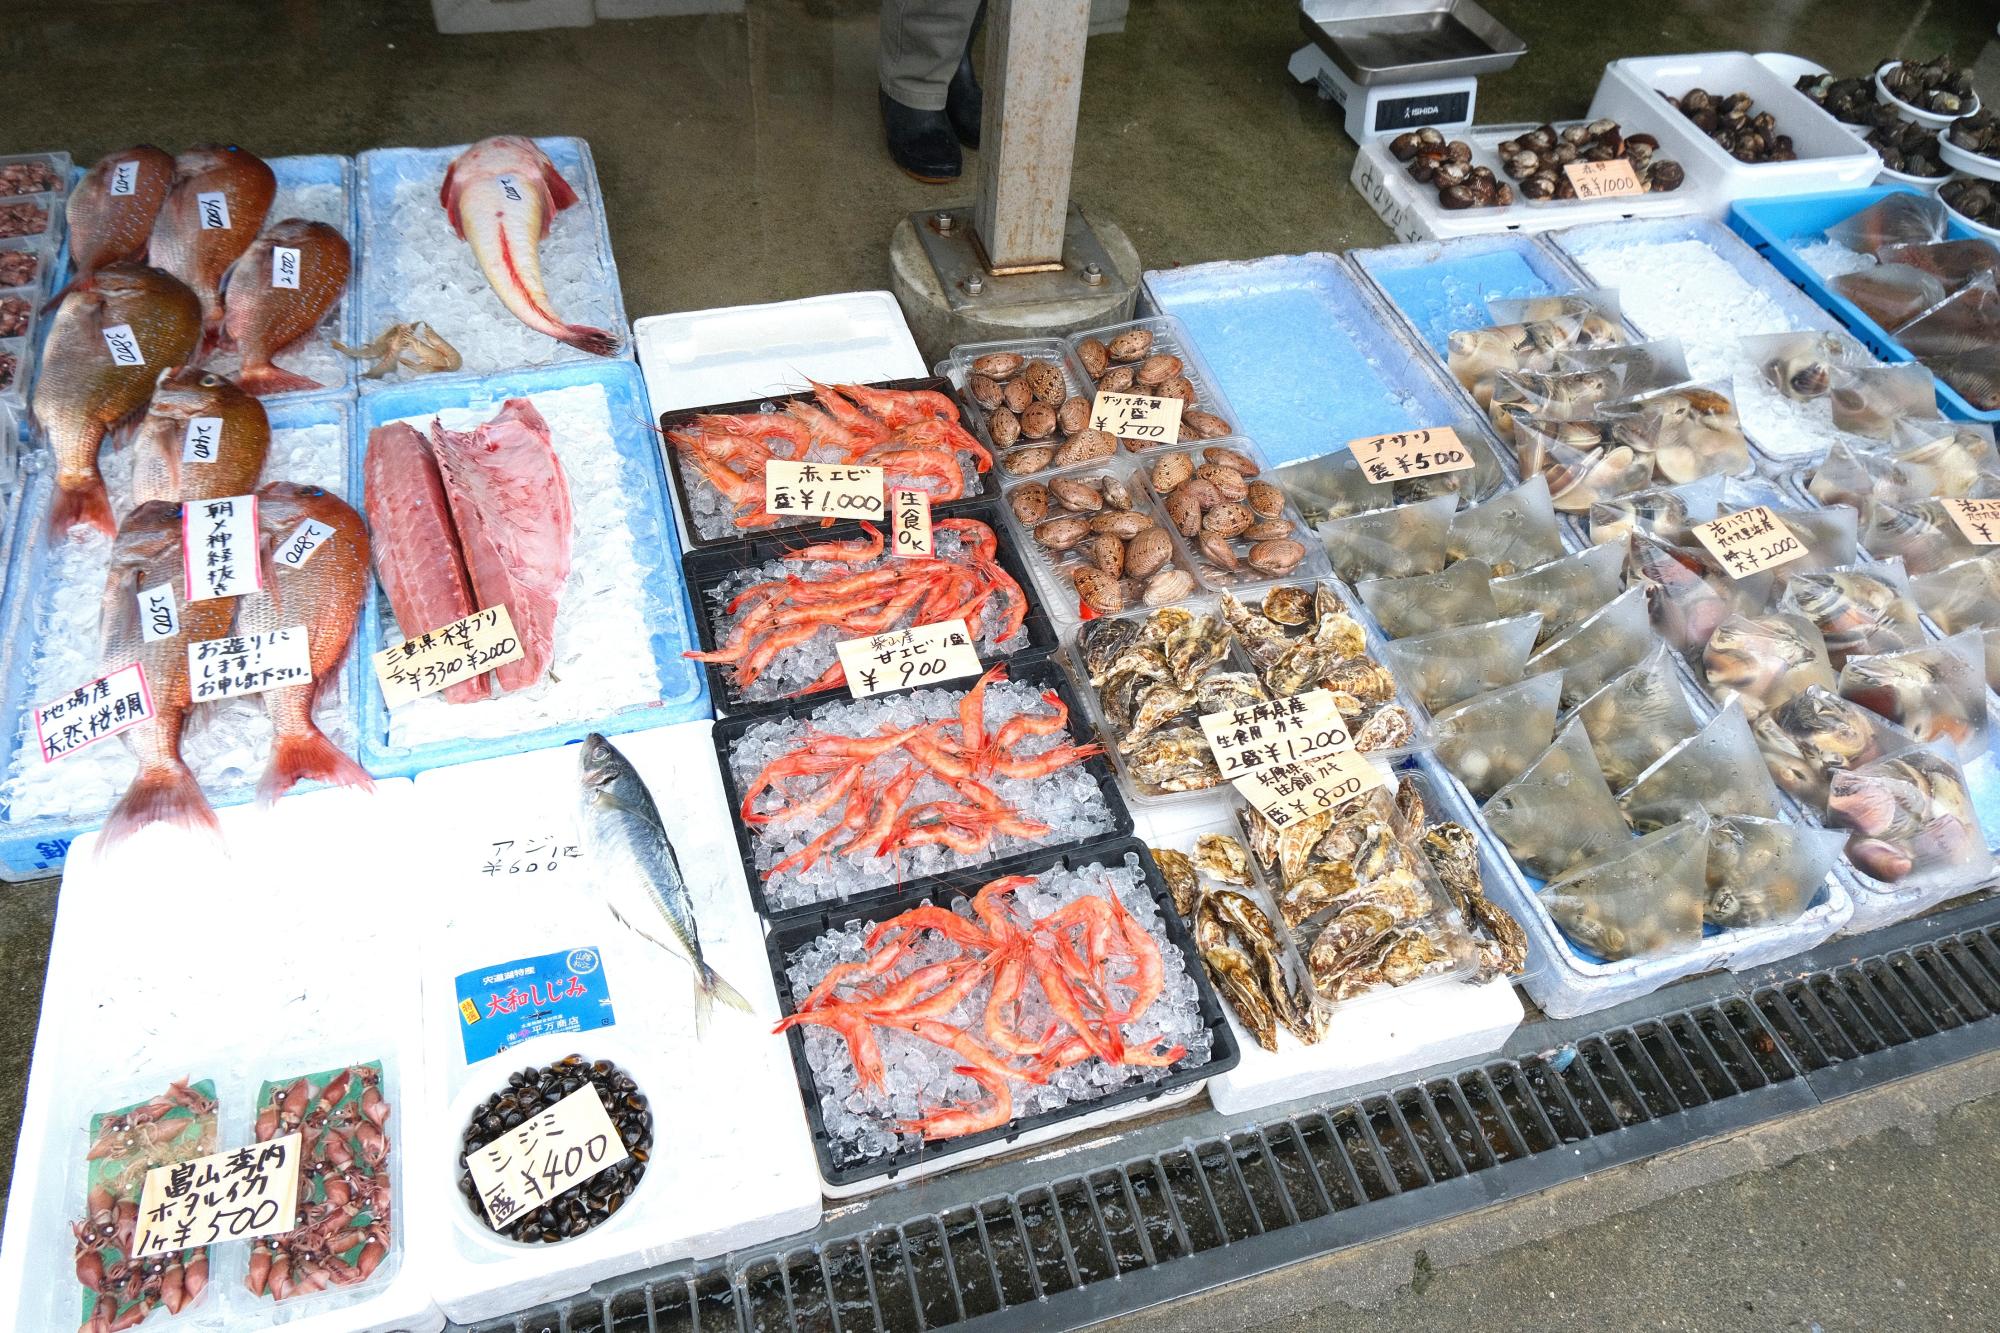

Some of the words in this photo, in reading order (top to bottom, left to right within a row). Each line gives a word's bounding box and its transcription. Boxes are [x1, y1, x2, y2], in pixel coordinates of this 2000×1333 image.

[1411, 105, 1439, 117] ISHIDA
[280, 251, 295, 285] 2500
[106, 332, 137, 363] 3800
[191, 425, 212, 459] 2400
[1368, 430, 1431, 453] アサリ
[798, 465, 871, 484] 赤エビ
[285, 524, 321, 564] 2800
[150, 596, 173, 635] 2500
[386, 633, 437, 666] 三重県
[873, 639, 935, 665] 甘エビ
[859, 658, 947, 692] ¥900
[40, 678, 112, 726] 地場産
[1229, 697, 1309, 727] 兵庫県産
[1216, 725, 1264, 749] 生食用
[1275, 716, 1304, 733] カキ
[482, 859, 558, 877] ¥600
[486, 975, 588, 1019] 大和しじみ
[488, 1113, 565, 1173] シジミ
[147, 1173, 269, 1223] ホタルイカ
